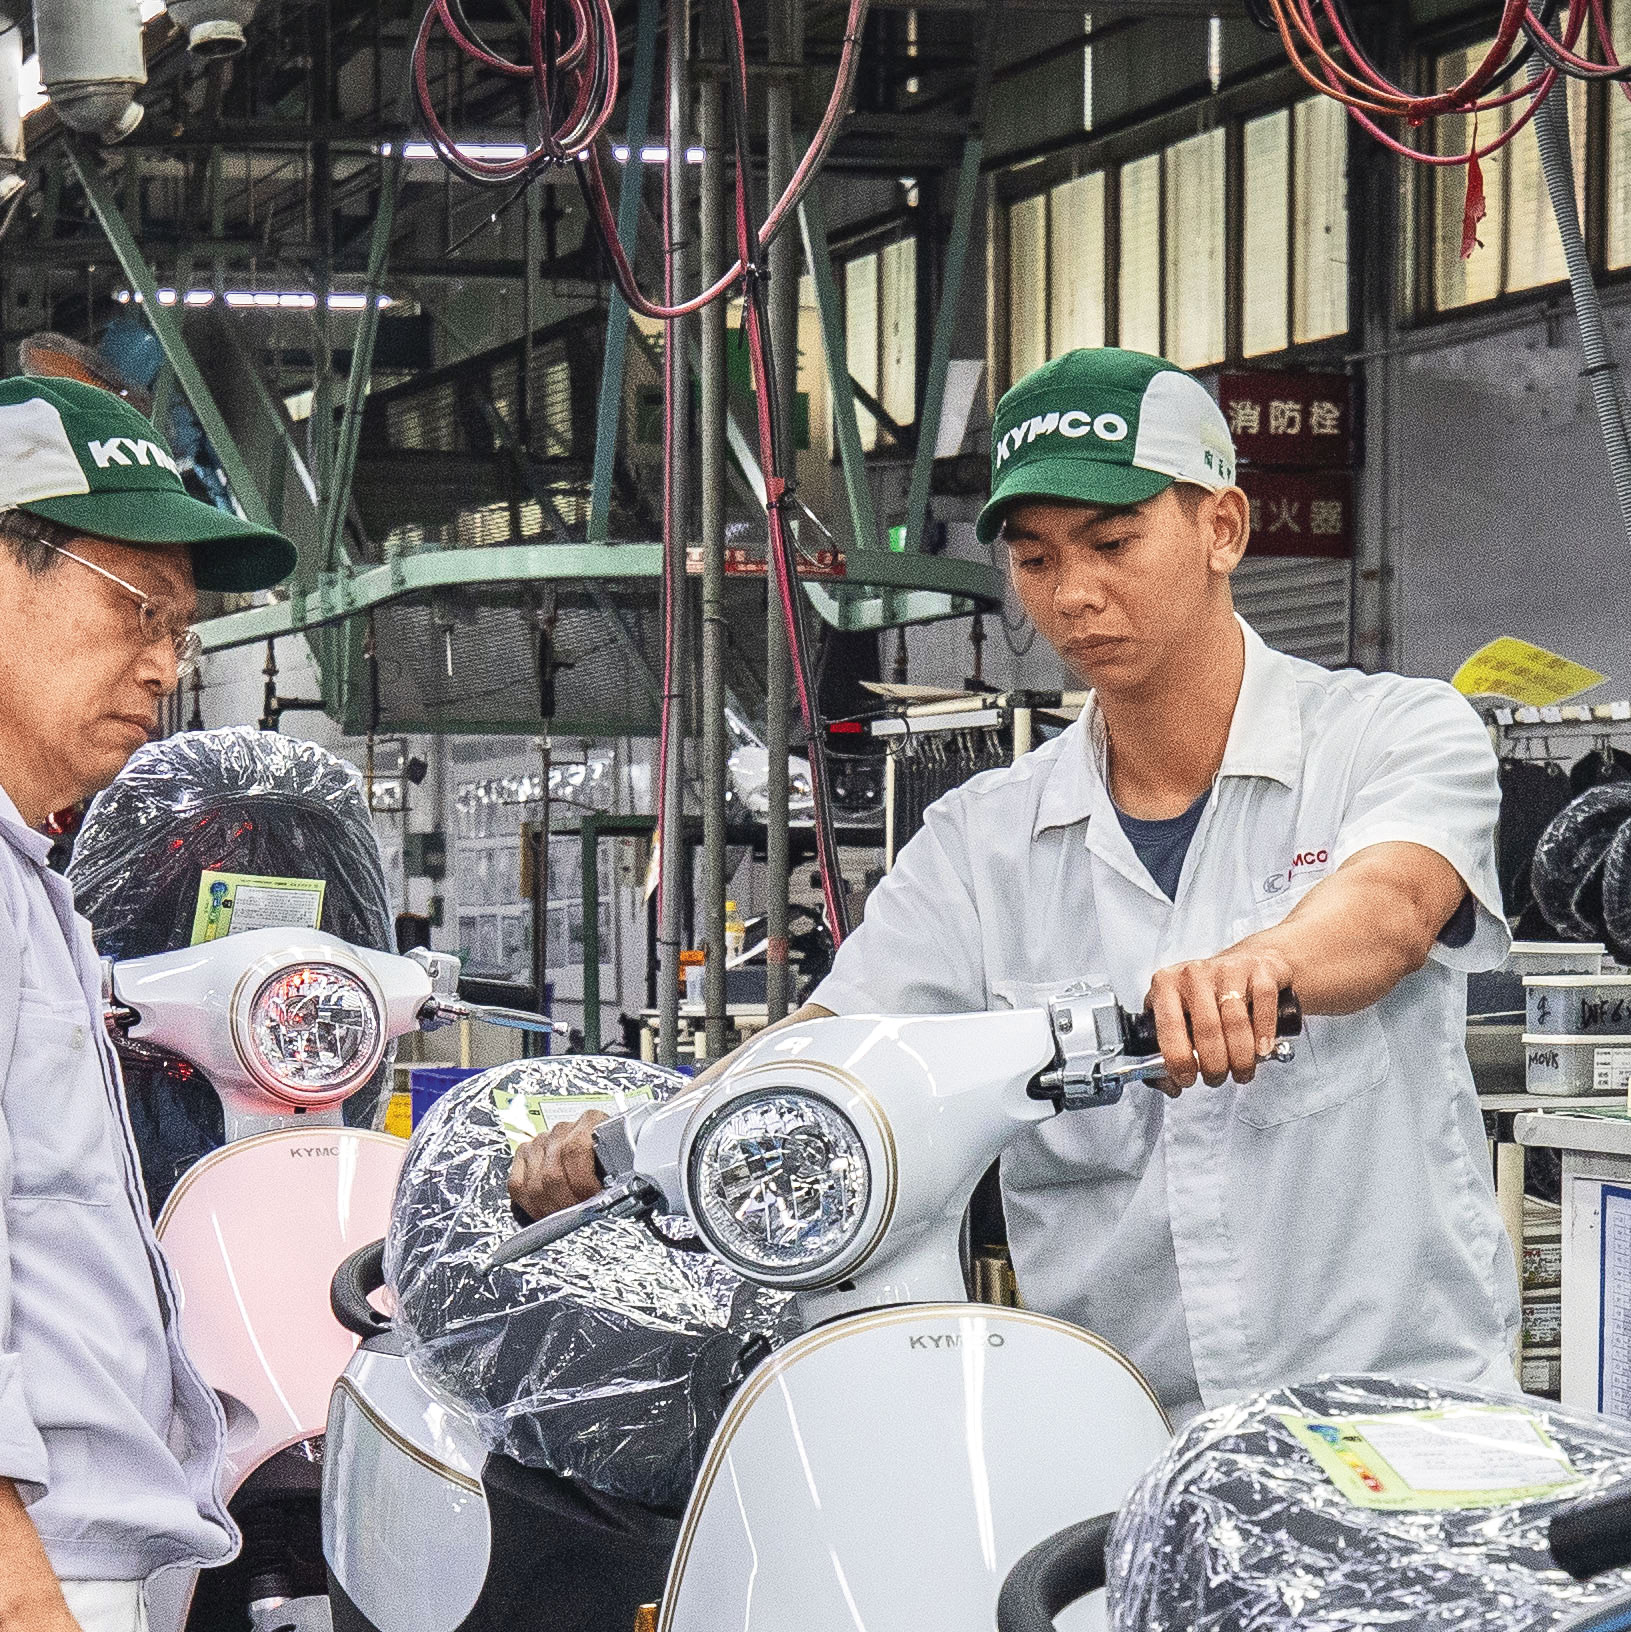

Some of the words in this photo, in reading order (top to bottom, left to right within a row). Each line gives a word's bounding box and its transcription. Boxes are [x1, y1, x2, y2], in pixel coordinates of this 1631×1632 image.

[1229, 399, 1342, 436] 消防栓
[995, 410, 1129, 470] KYMCO
[289, 1146, 342, 1158] KYMC
[908, 1333, 1005, 1350] KYMO
